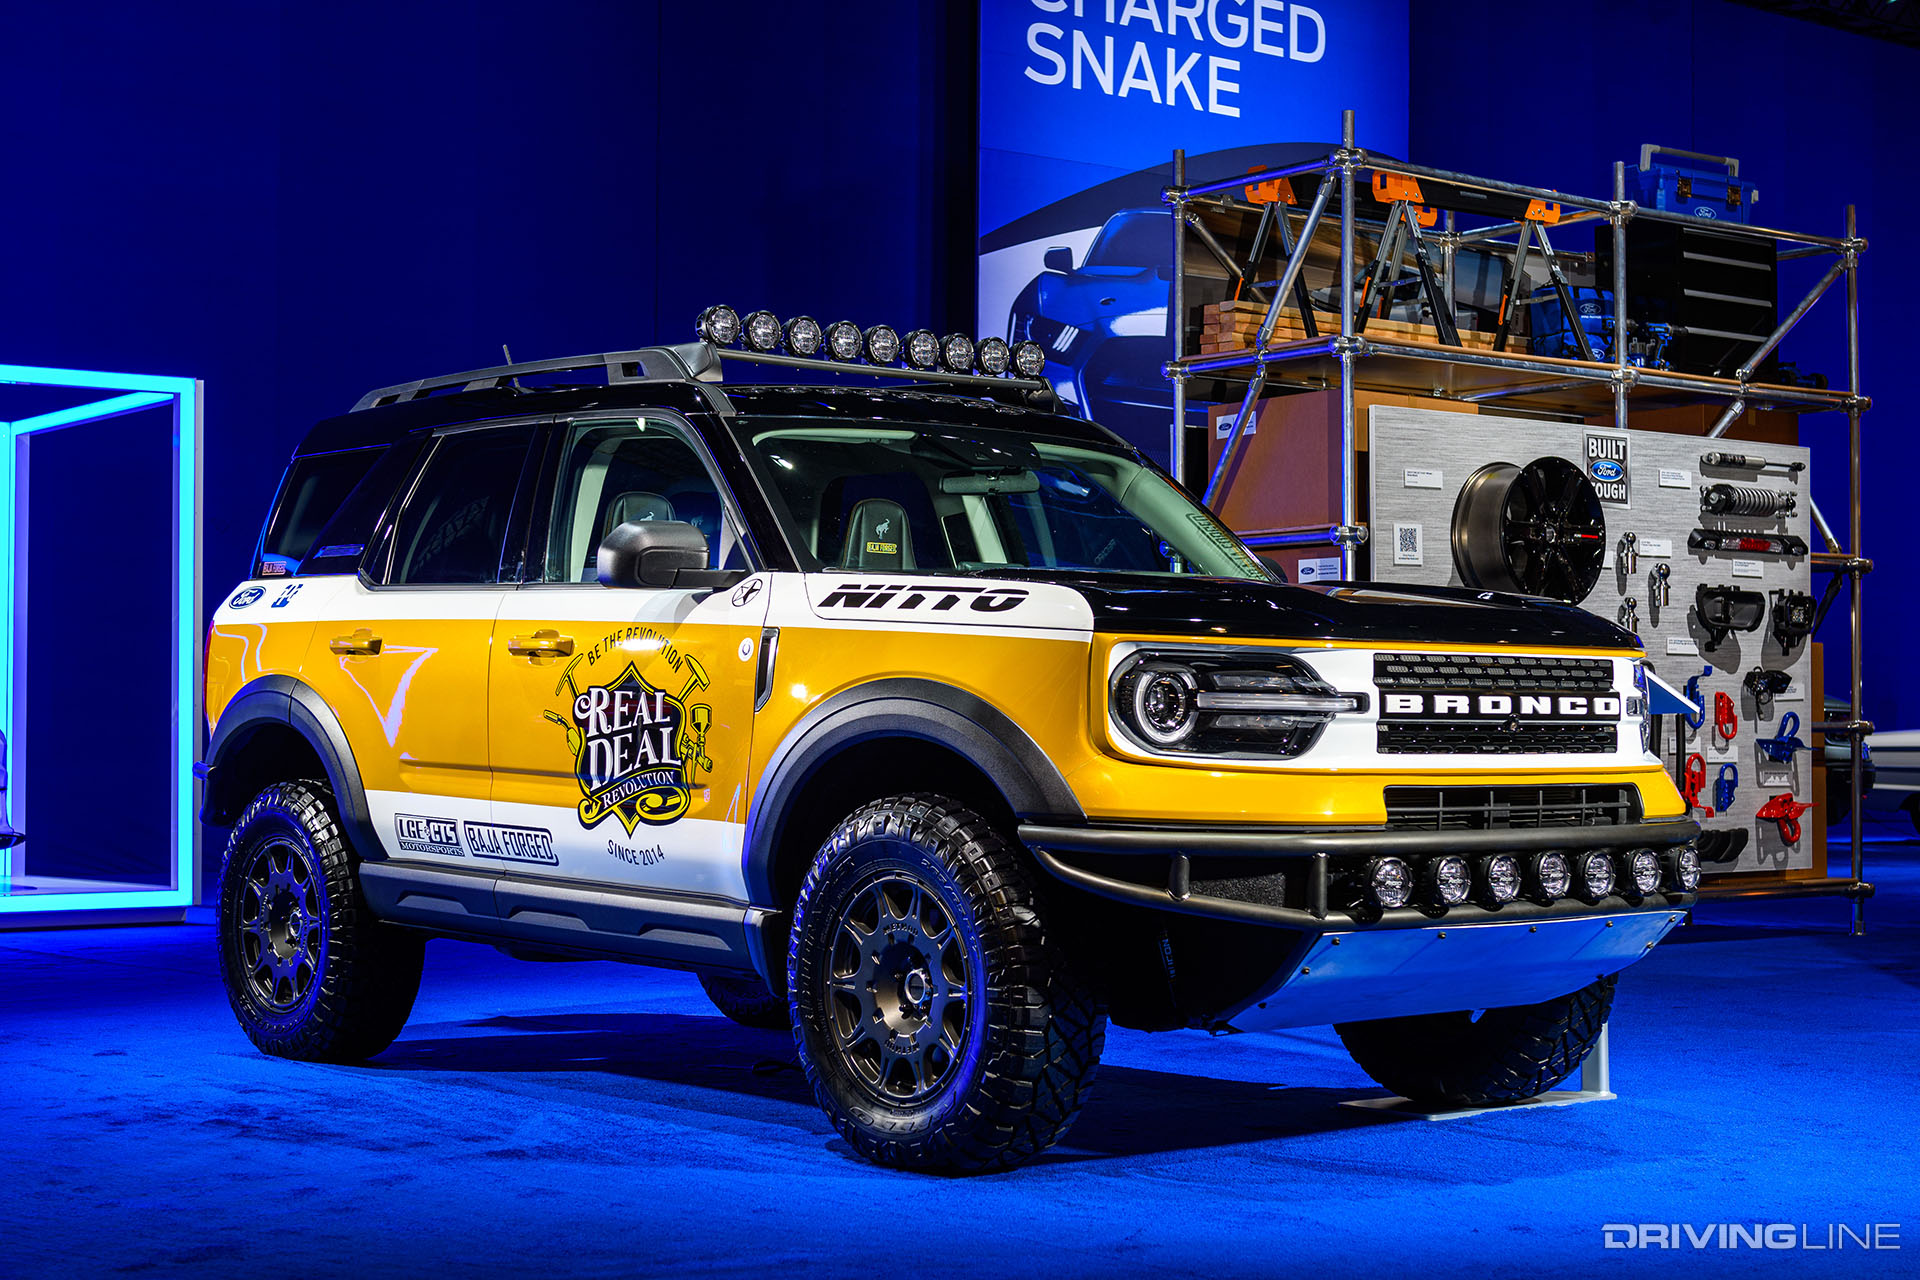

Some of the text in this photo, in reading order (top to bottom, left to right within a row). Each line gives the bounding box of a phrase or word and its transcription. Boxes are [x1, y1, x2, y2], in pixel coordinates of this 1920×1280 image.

[1030, 0, 1326, 63] ARGED
[1024, 22, 1240, 118] SNAKE
[1588, 437, 1626, 460] BUILT
[1597, 463, 1617, 477] Ford
[1591, 481, 1626, 500] OUGH
[231, 588, 261, 606] Ford
[817, 583, 1030, 612] NITTO
[587, 643, 602, 667] BE
[602, 629, 623, 653] THE
[574, 687, 671, 738] REAL
[1384, 693, 1621, 716] BRONCO
[587, 726, 682, 792] DEAL
[601, 771, 675, 809] REVOLUTION
[399, 818, 457, 844] LGE CTS
[467, 827, 554, 861] BAJA FORGED
[401, 841, 464, 857] MOTORSPORTS
[607, 839, 665, 866] SINCE 2014
